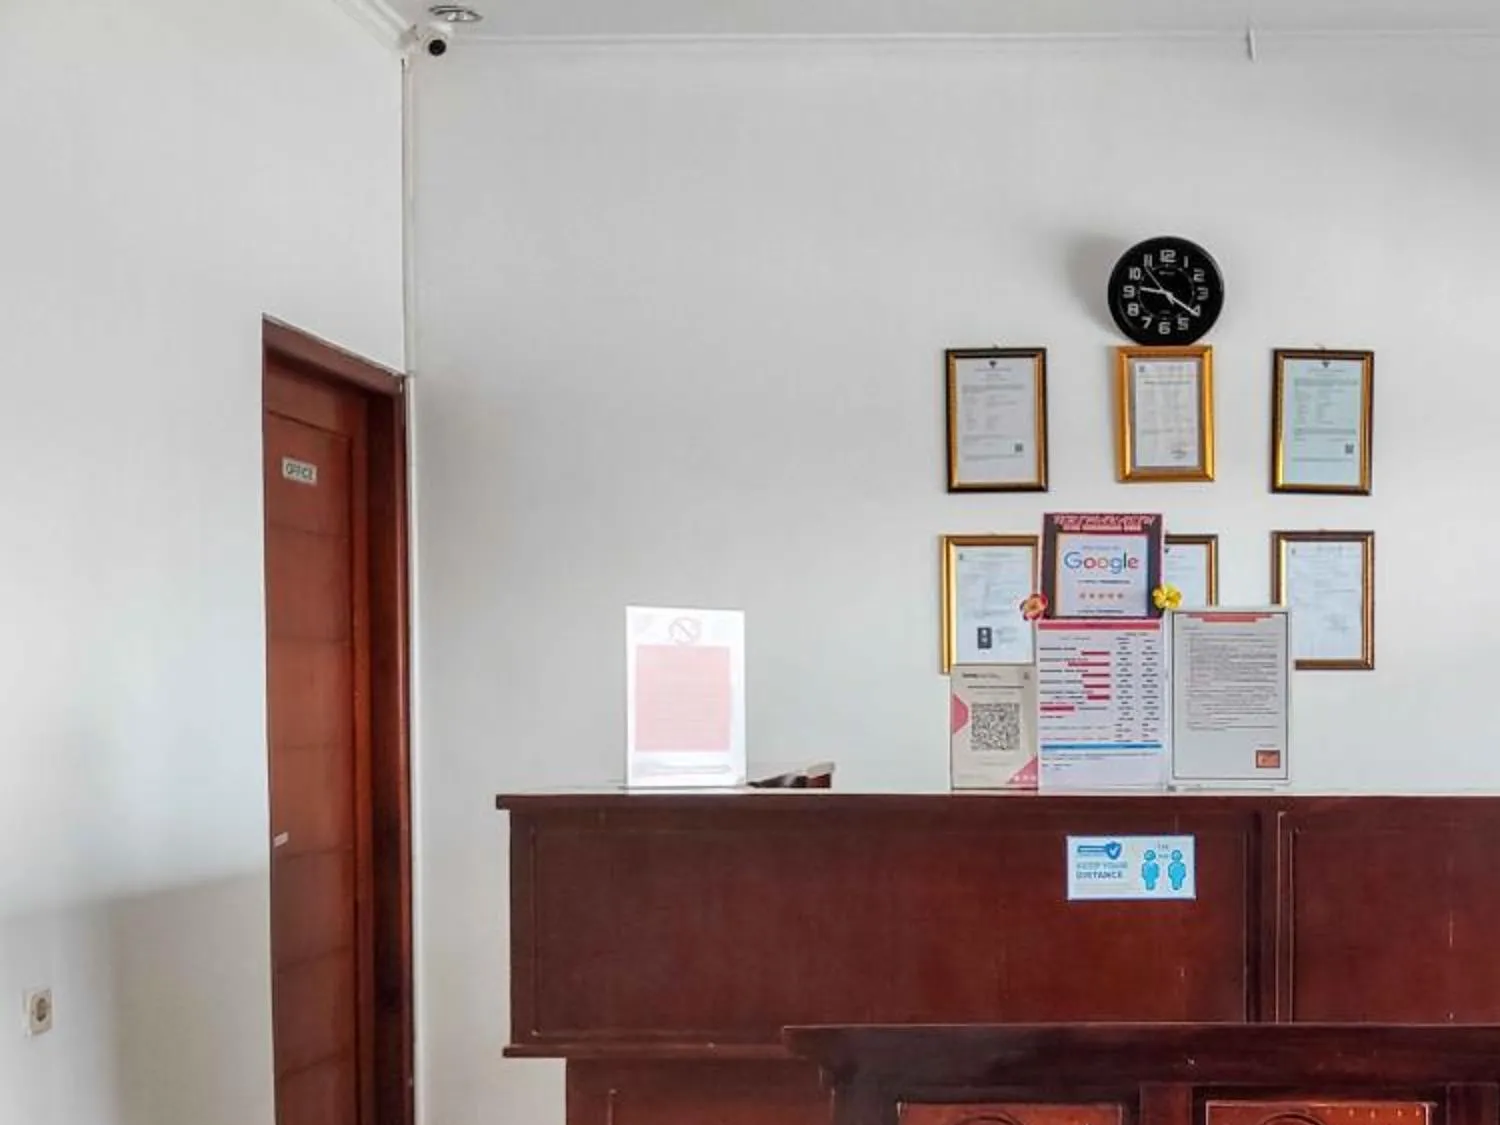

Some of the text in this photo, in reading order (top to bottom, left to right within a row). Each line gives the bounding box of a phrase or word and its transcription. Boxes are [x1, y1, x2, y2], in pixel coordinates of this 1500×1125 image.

[1159, 249, 1176, 263] 12
[1129, 267, 1141, 281] 10
[1193, 268, 1205, 282] 2
[1123, 285, 1135, 299] 9
[1196, 287, 1208, 301] 3
[1127, 303, 1139, 317] 8
[1141, 316, 1153, 329] 7
[1158, 321, 1171, 336] 6
[1177, 317, 1190, 331] 5
[1064, 551, 1139, 575] Google
